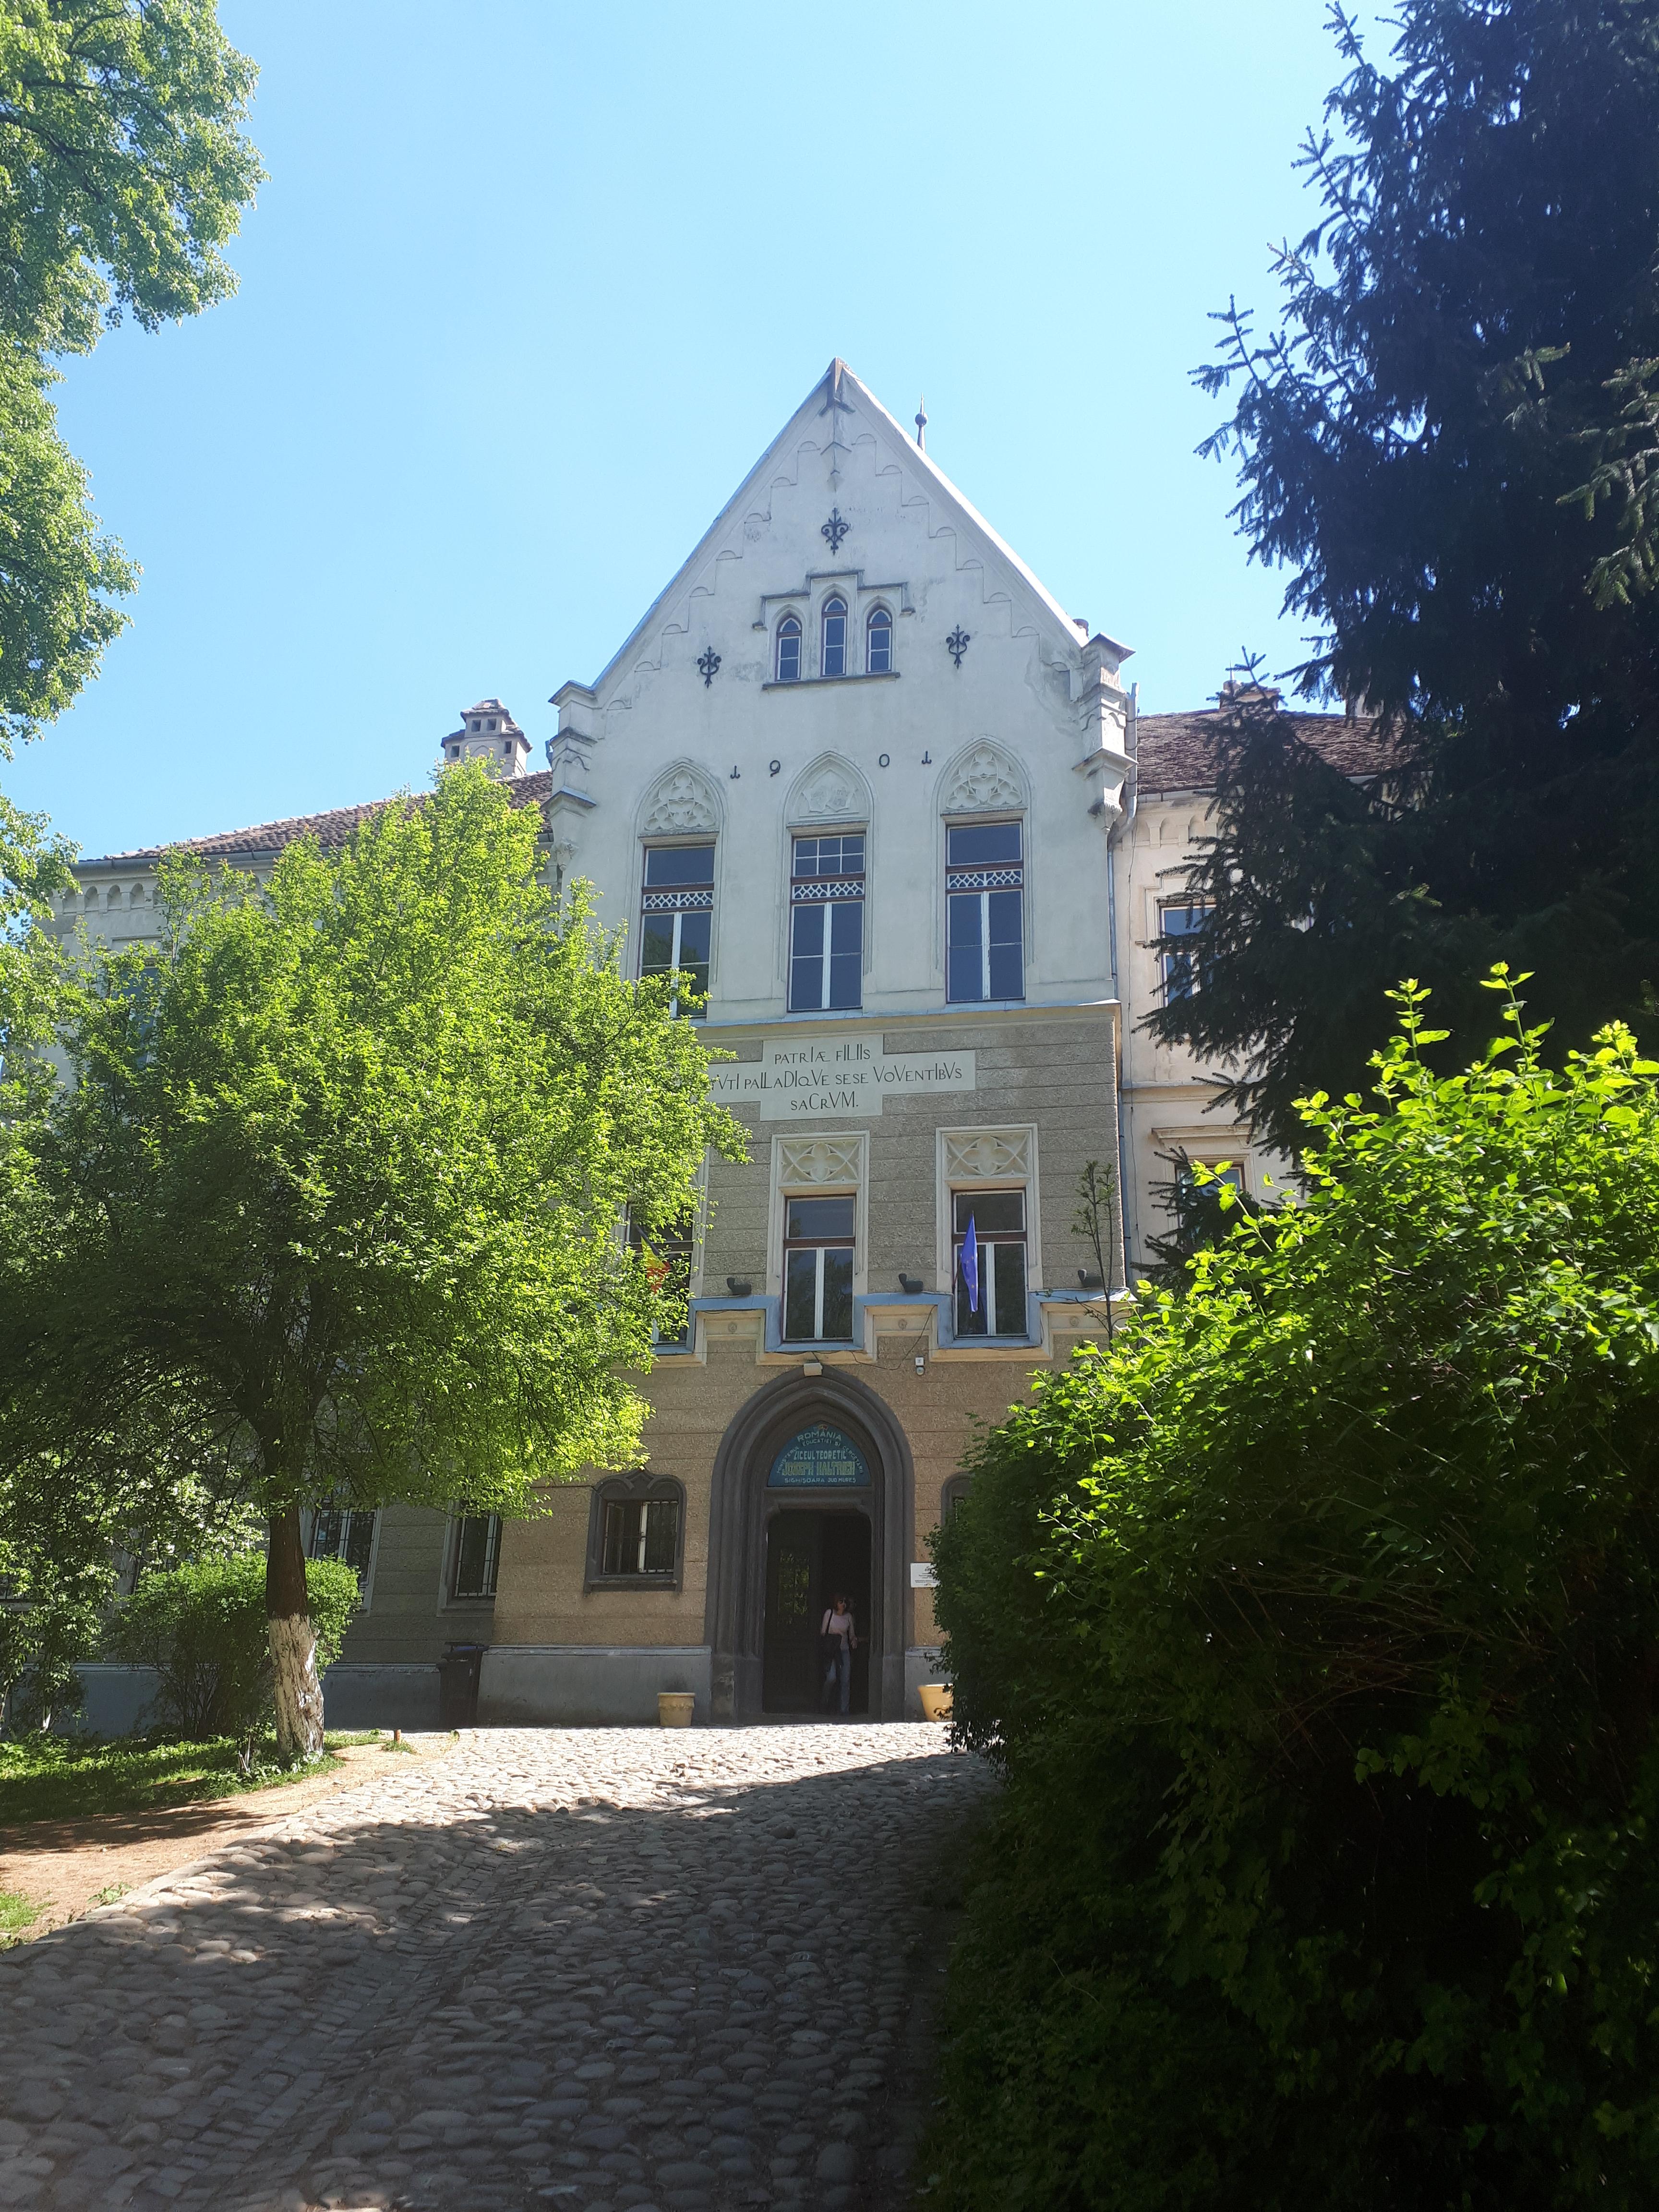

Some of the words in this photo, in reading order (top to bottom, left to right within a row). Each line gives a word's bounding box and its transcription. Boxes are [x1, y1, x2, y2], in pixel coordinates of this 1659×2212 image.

[836, 1043, 871, 1061] FILIIS
[835, 1073, 869, 1085] SESE
[793, 1450, 816, 1460] LICEUL
[816, 1450, 847, 1460] TEORETIC
[781, 1461, 814, 1476] JOSEPH
[816, 1461, 855, 1476] HALTRICH
